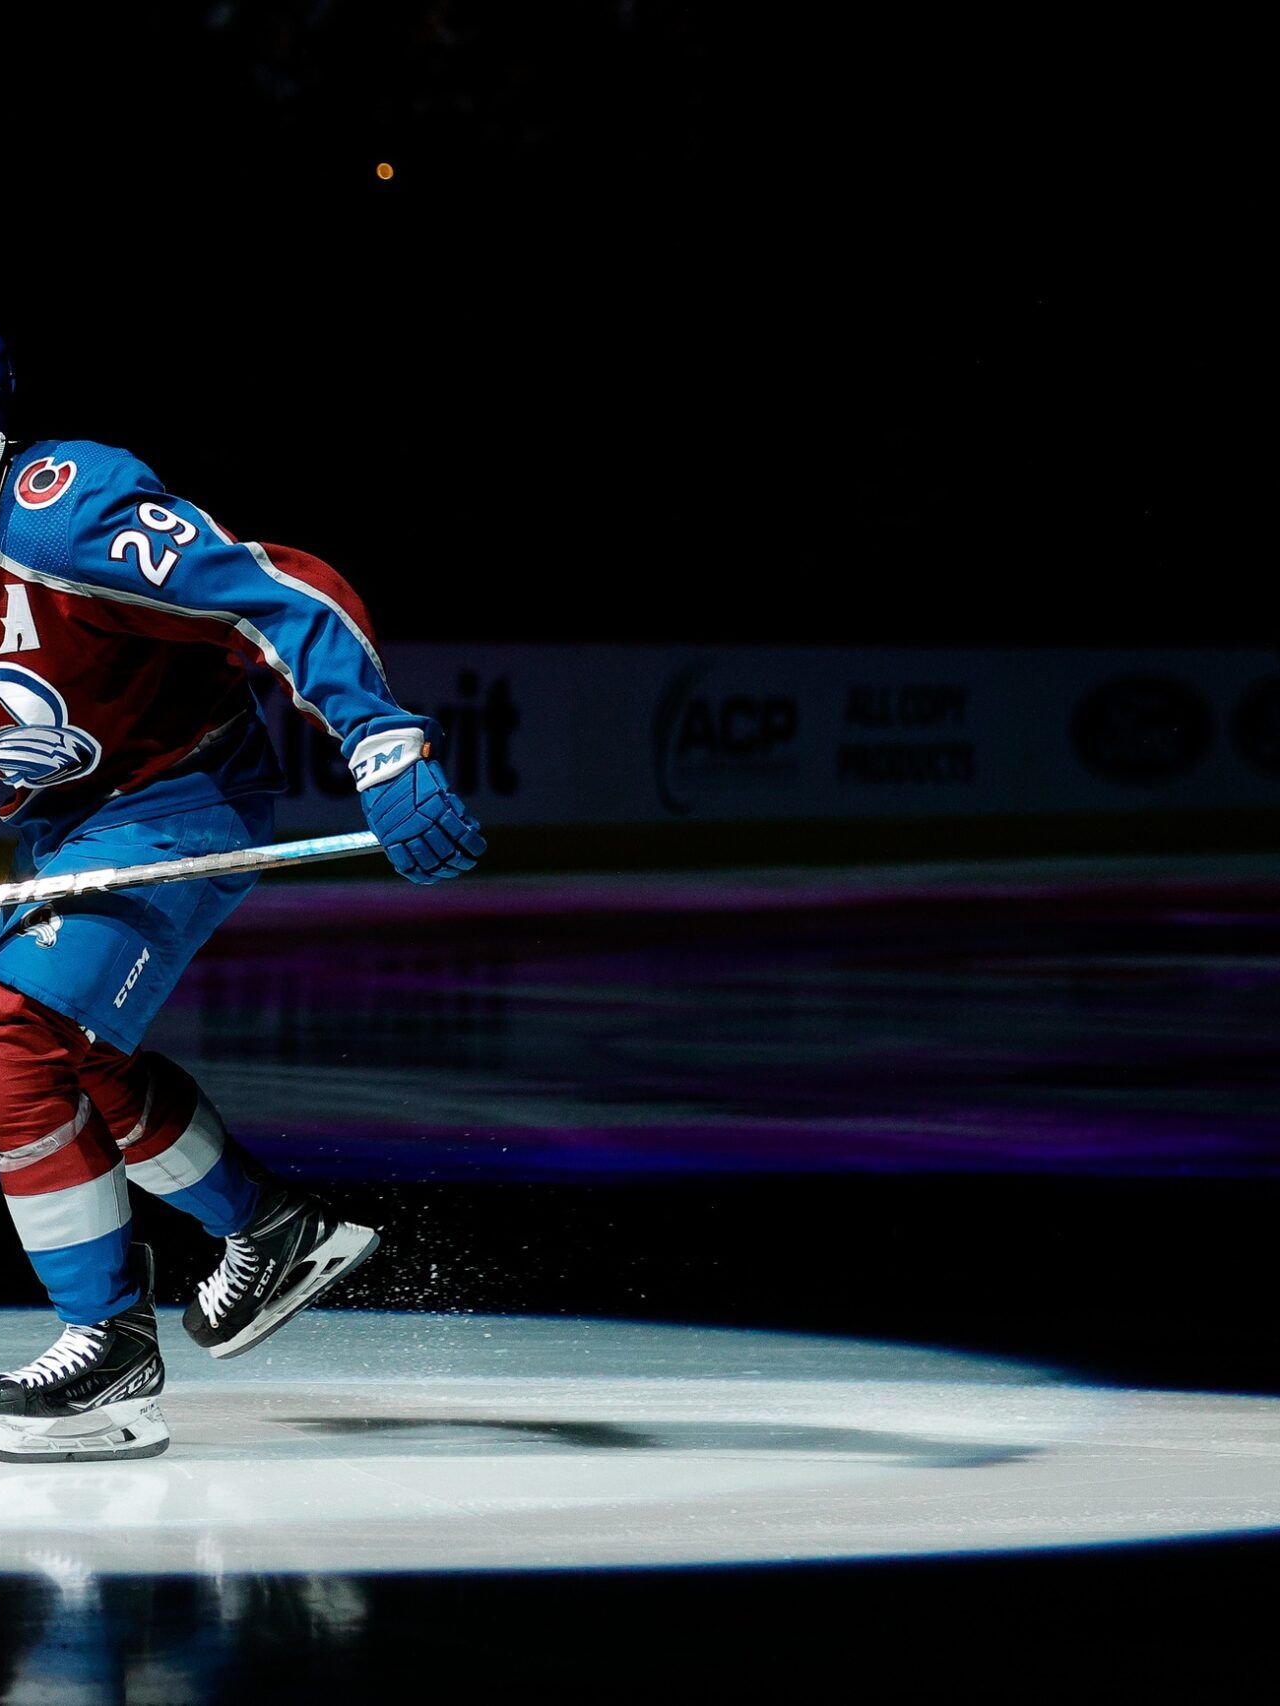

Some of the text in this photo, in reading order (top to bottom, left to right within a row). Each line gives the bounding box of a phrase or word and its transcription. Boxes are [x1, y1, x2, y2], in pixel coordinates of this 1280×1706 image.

[108, 501, 200, 590] 29
[677, 694, 798, 756] ACP
[112, 946, 150, 1009] CCM
[253, 1258, 276, 1298] CCM
